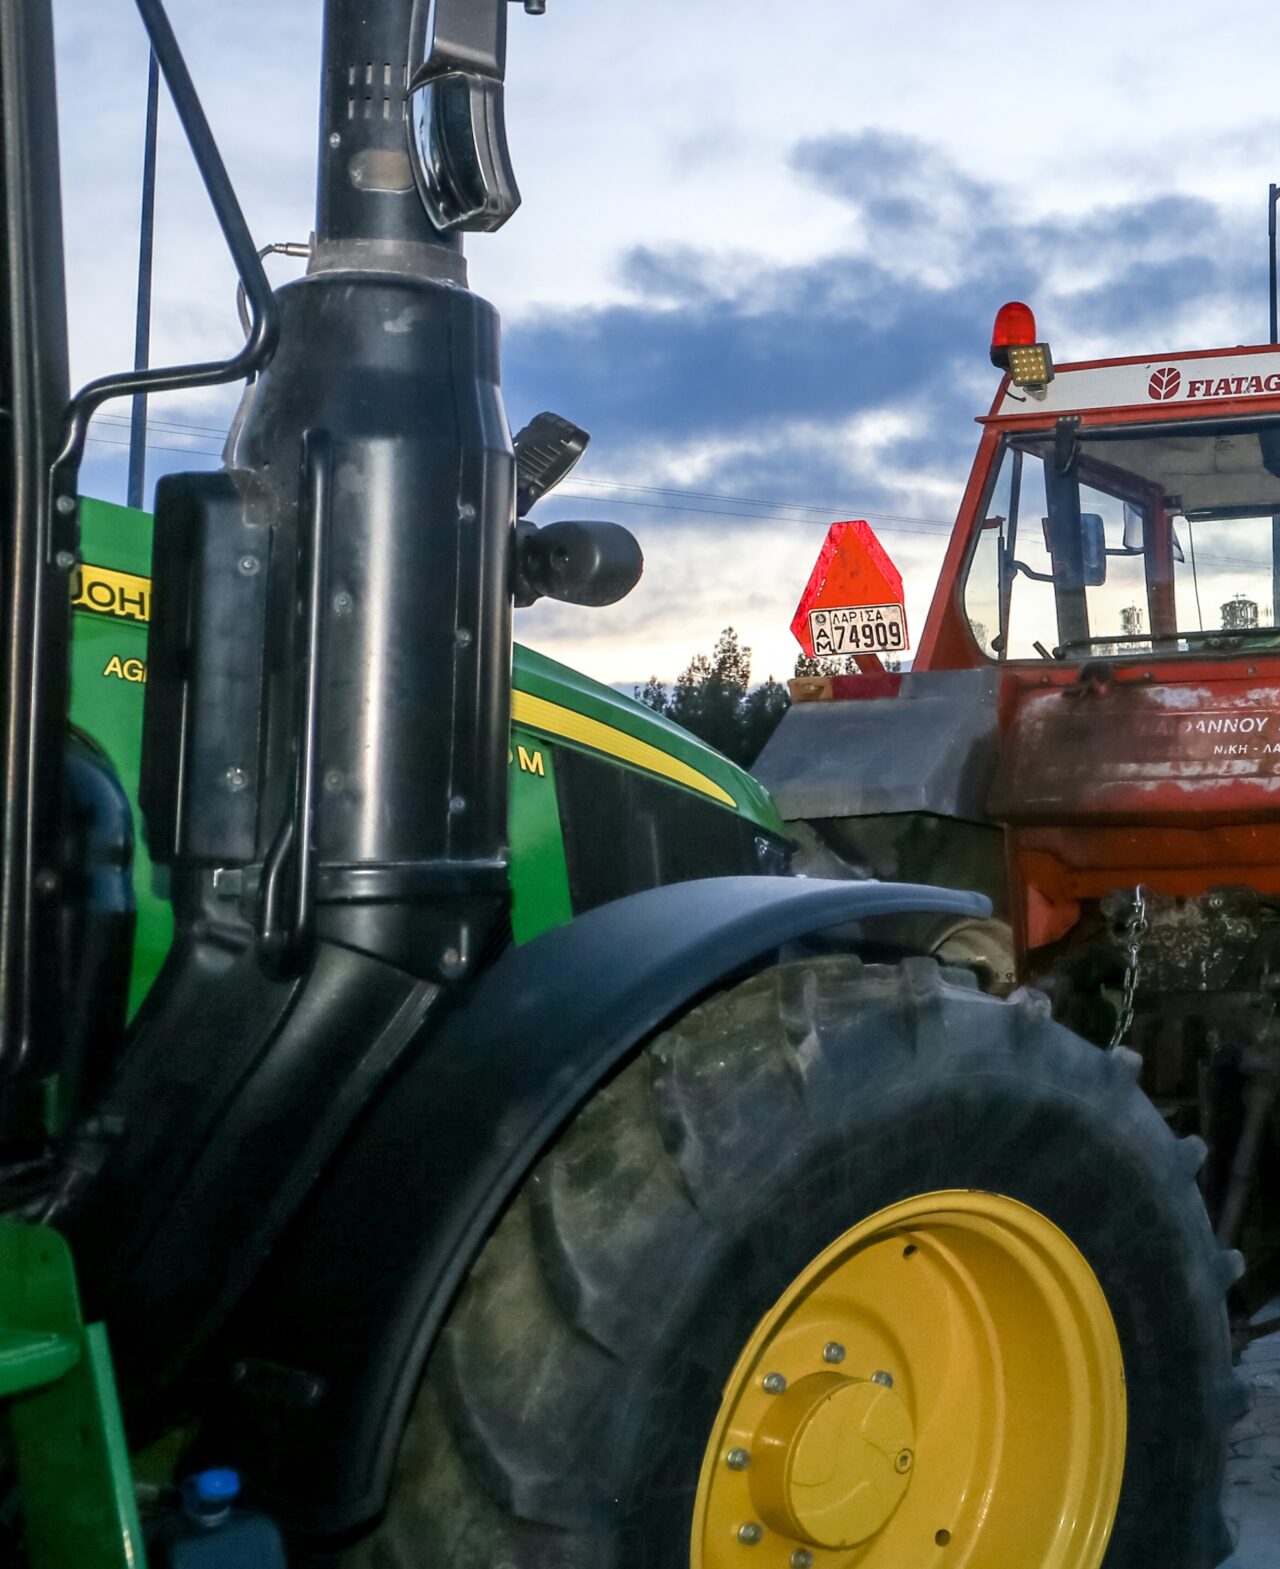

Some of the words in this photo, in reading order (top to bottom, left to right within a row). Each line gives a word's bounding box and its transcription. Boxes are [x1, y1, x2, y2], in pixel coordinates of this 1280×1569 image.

[71, 571, 152, 616] JOH
[832, 609, 884, 625] ΛΑΡΙΣΑ
[834, 621, 902, 650] 74909
[103, 656, 148, 683] AG
